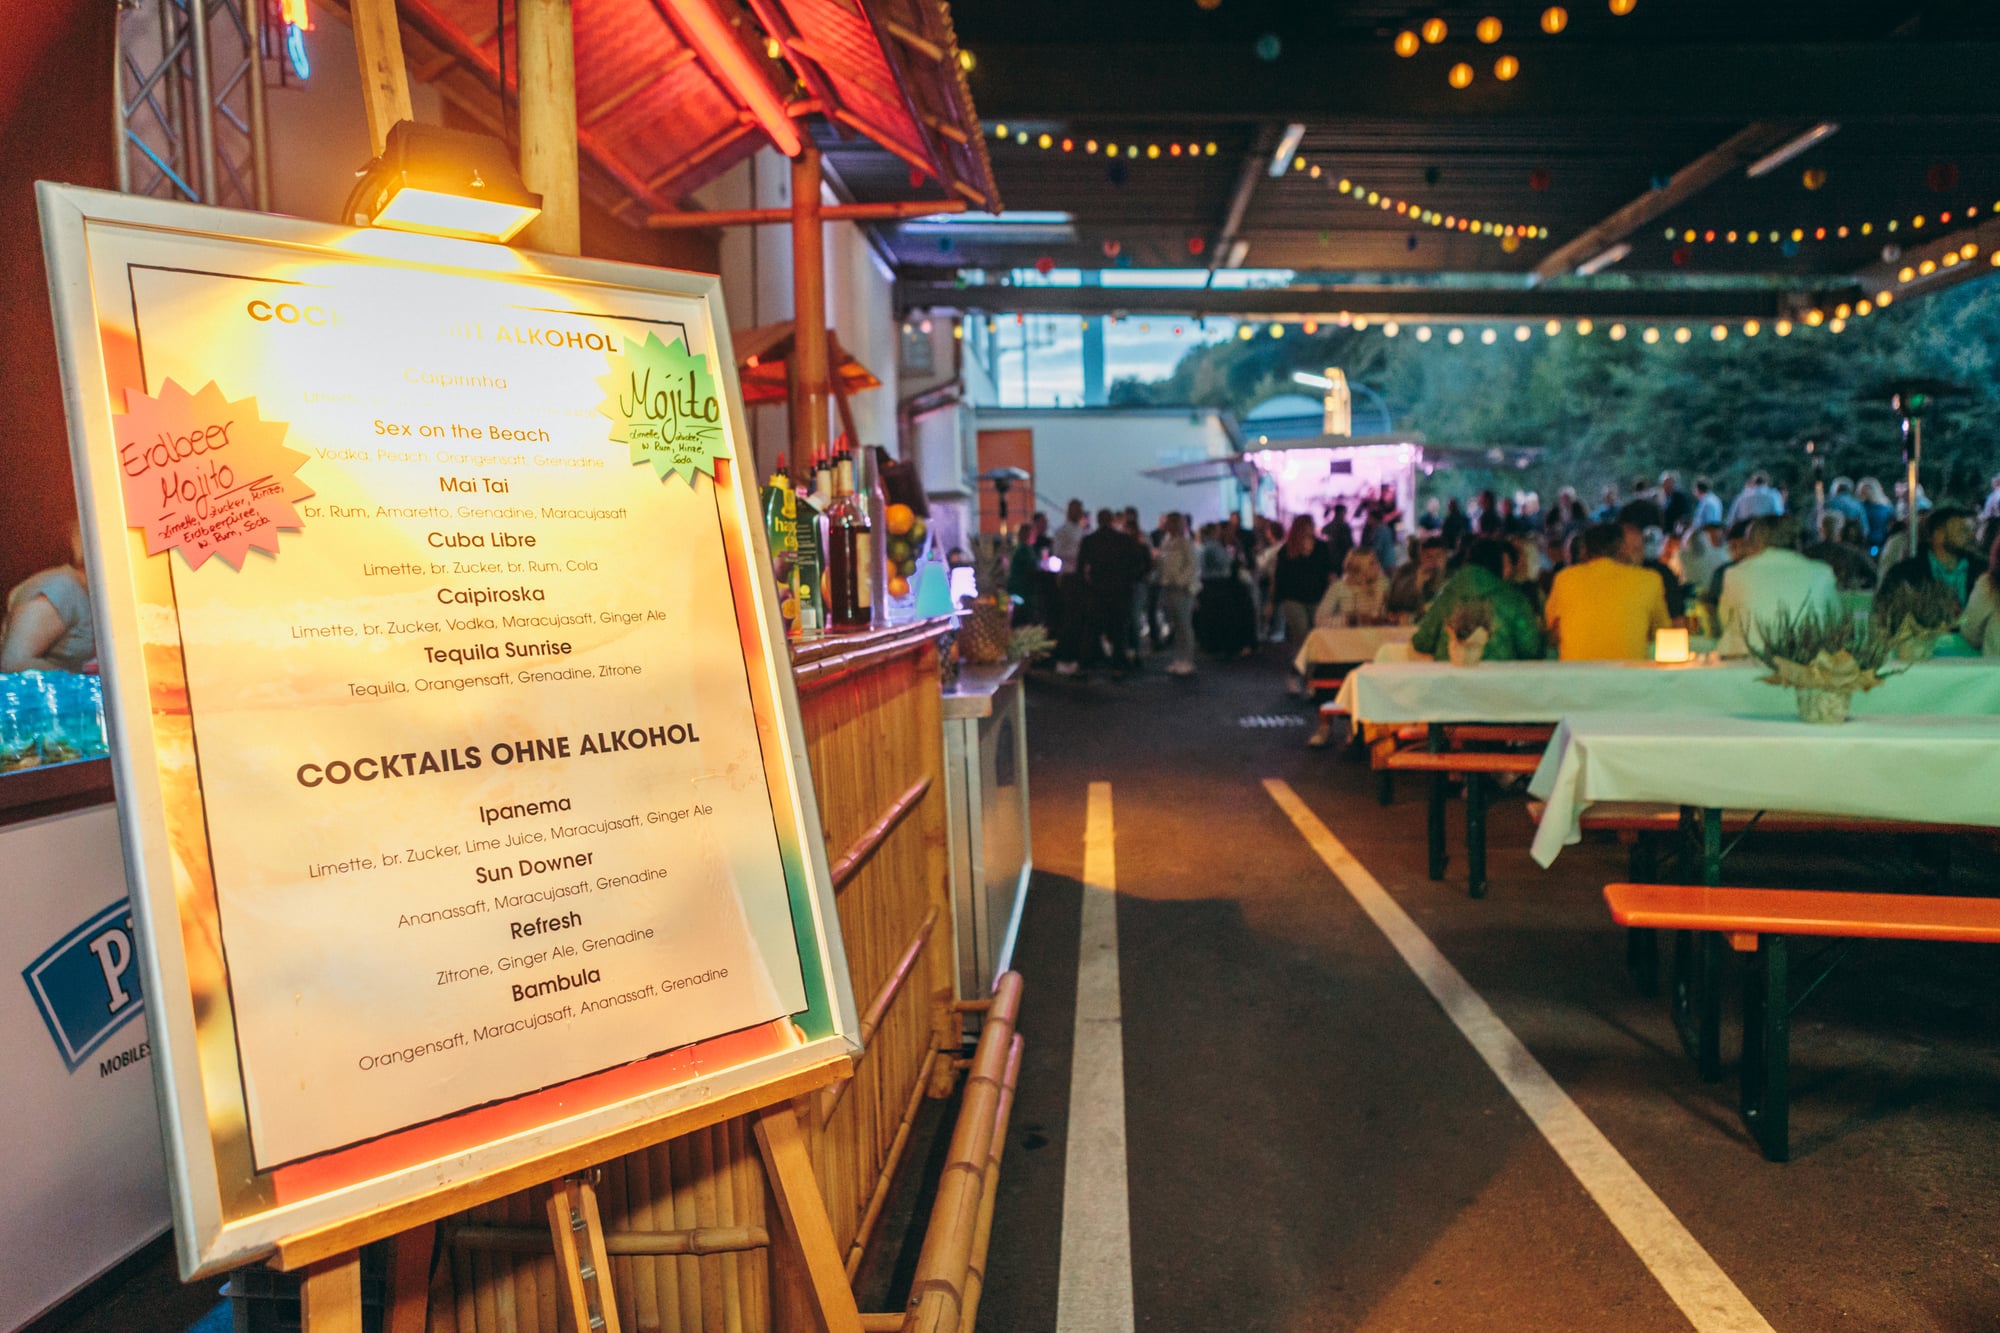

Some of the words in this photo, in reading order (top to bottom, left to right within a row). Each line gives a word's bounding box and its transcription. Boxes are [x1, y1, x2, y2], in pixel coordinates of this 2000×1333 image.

[495, 325, 617, 353] ALKOHOL
[404, 367, 508, 391] Caipirinha
[620, 367, 719, 444] Mojito
[374, 419, 411, 438] Sex
[419, 424, 446, 439] on
[451, 420, 485, 440] the
[489, 423, 550, 443] Beach
[120, 421, 234, 477] Erdbeer
[316, 447, 370, 464] Vodka,
[533, 452, 604, 468] Grenadine
[672, 453, 693, 464] Soda
[161, 459, 234, 520] Mojito
[439, 476, 477, 494] Mai
[482, 476, 509, 494] Tai
[304, 504, 326, 518] br.
[330, 505, 370, 519] Rum,
[376, 505, 453, 520] Amaretto,
[457, 505, 536, 520] Grenadine,
[541, 505, 627, 522] Maracujasaft
[427, 531, 485, 549] Cuba
[490, 531, 536, 548] Libre
[363, 561, 426, 577] Limette,
[430, 561, 449, 575] br.
[453, 559, 503, 576] Zucker,
[507, 560, 525, 574] br.
[528, 560, 562, 575] Rum,
[566, 558, 598, 573] Cola
[437, 585, 545, 607] Caipiroska
[291, 624, 357, 639] Limette,
[363, 622, 383, 636] br.
[387, 619, 442, 636] Zucker,
[446, 616, 498, 633] Vodka,
[502, 612, 596, 632] Maracujasaft,
[600, 610, 643, 628] Ginger
[647, 608, 667, 622] Ale
[424, 643, 499, 666] Tequila
[505, 638, 572, 659] Sunrise
[348, 679, 410, 698] Tequila,
[414, 671, 514, 693] Orangensaft,
[517, 665, 595, 684] Grenadine,
[599, 662, 642, 678] Zitrone
[296, 747, 482, 788] COCKTAILS
[490, 735, 572, 767] OHNE
[579, 722, 700, 756] ALKOHOL
[479, 796, 572, 825] Ipanema
[309, 856, 377, 878] Limette,
[382, 851, 402, 867] br.
[406, 842, 461, 864] Zucker,
[465, 836, 501, 855] Lime
[504, 829, 547, 849] Juice,
[550, 815, 644, 840] Maracujasaft,
[646, 808, 690, 828] Ginger
[692, 803, 713, 819] Ale
[475, 862, 514, 885] Sun
[519, 850, 594, 877] Downer
[398, 900, 490, 928] Ananassaft,
[494, 880, 592, 910] Maracujasaft,
[596, 866, 668, 891] Grenadine
[510, 910, 582, 940] Refresh
[89, 917, 141, 1014] P
[436, 963, 494, 986] Zitrone,
[497, 951, 548, 973] Ginger
[550, 942, 578, 960] Ale,
[581, 927, 654, 952] Grenadine
[511, 966, 601, 1002] Bambula
[358, 1032, 469, 1071] Orangensaft,
[473, 1006, 577, 1044] Maracujasaft,
[580, 984, 658, 1014] Ananassaft,
[661, 966, 728, 995] Grenadine
